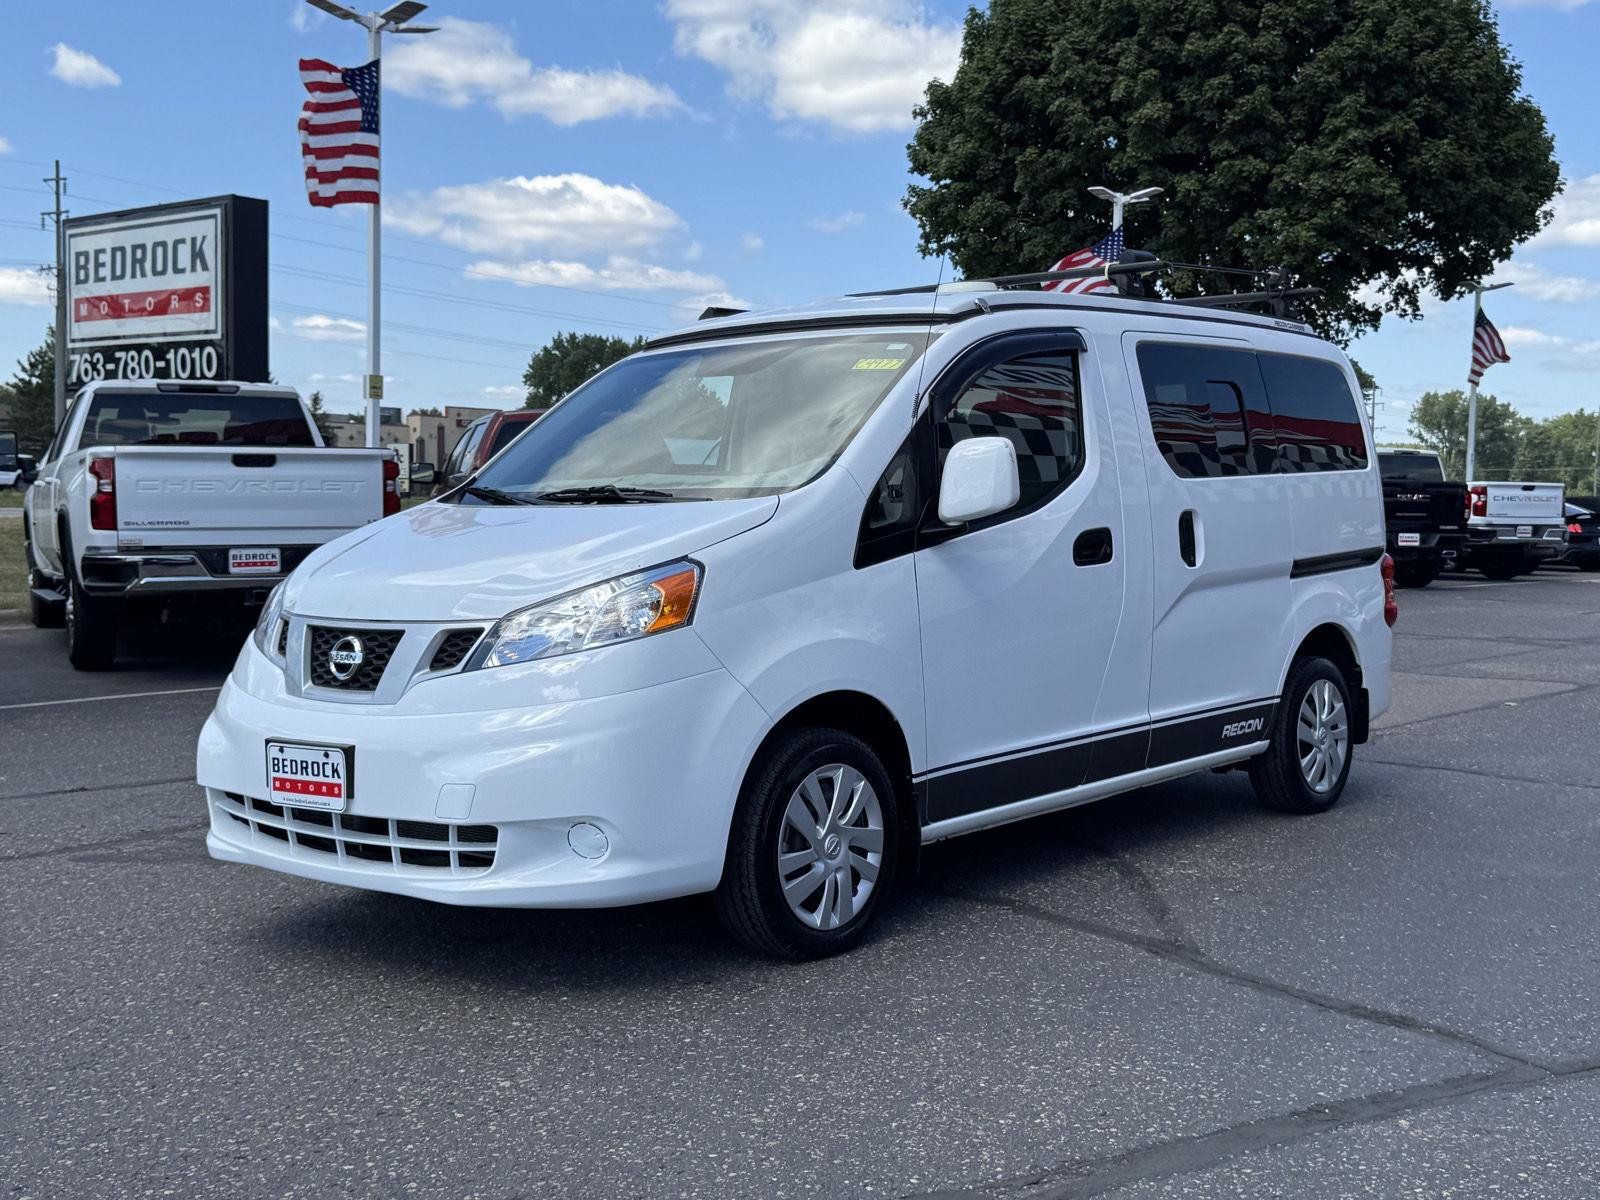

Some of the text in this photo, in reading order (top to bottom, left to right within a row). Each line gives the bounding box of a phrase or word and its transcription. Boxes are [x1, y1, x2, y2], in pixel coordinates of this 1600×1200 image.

[74, 235, 210, 286] BEDROCK
[79, 292, 204, 317] MOTORS
[68, 345, 218, 384] 763-780-1010
[136, 479, 367, 493] CHEVROLET
[1221, 717, 1264, 739] RECON
[272, 757, 341, 779] BEDROCK
[275, 781, 339, 794] MOTORS
